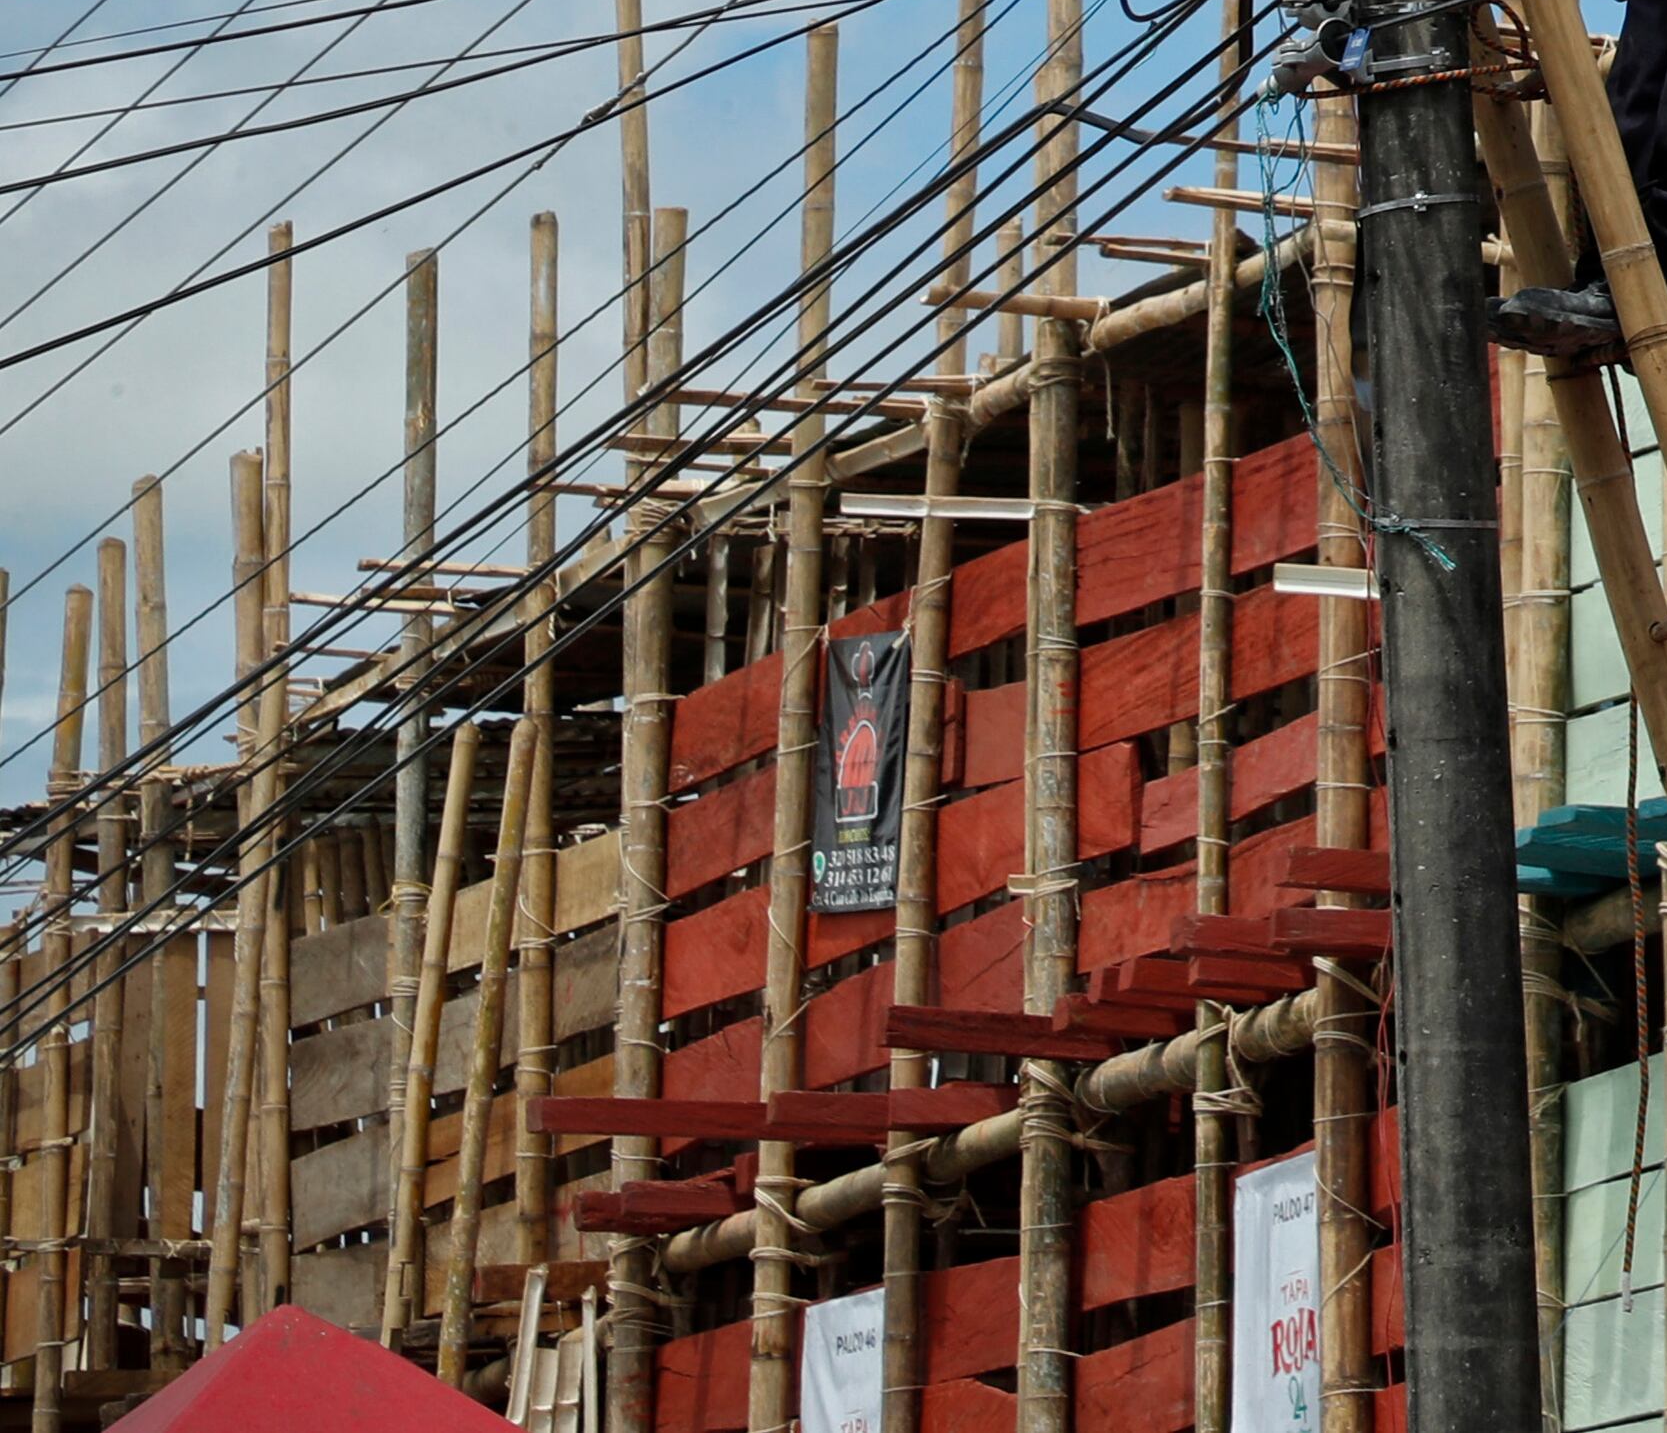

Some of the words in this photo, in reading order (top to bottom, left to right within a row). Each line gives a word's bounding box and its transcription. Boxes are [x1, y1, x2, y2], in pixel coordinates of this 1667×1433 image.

[864, 846, 880, 864] 83
[881, 845, 895, 862] 48
[866, 867, 880, 884] 12
[1273, 1197, 1302, 1225] PALCO
[1280, 1278, 1310, 1306] TAPA
[1270, 1307, 1320, 1378] ROJA
